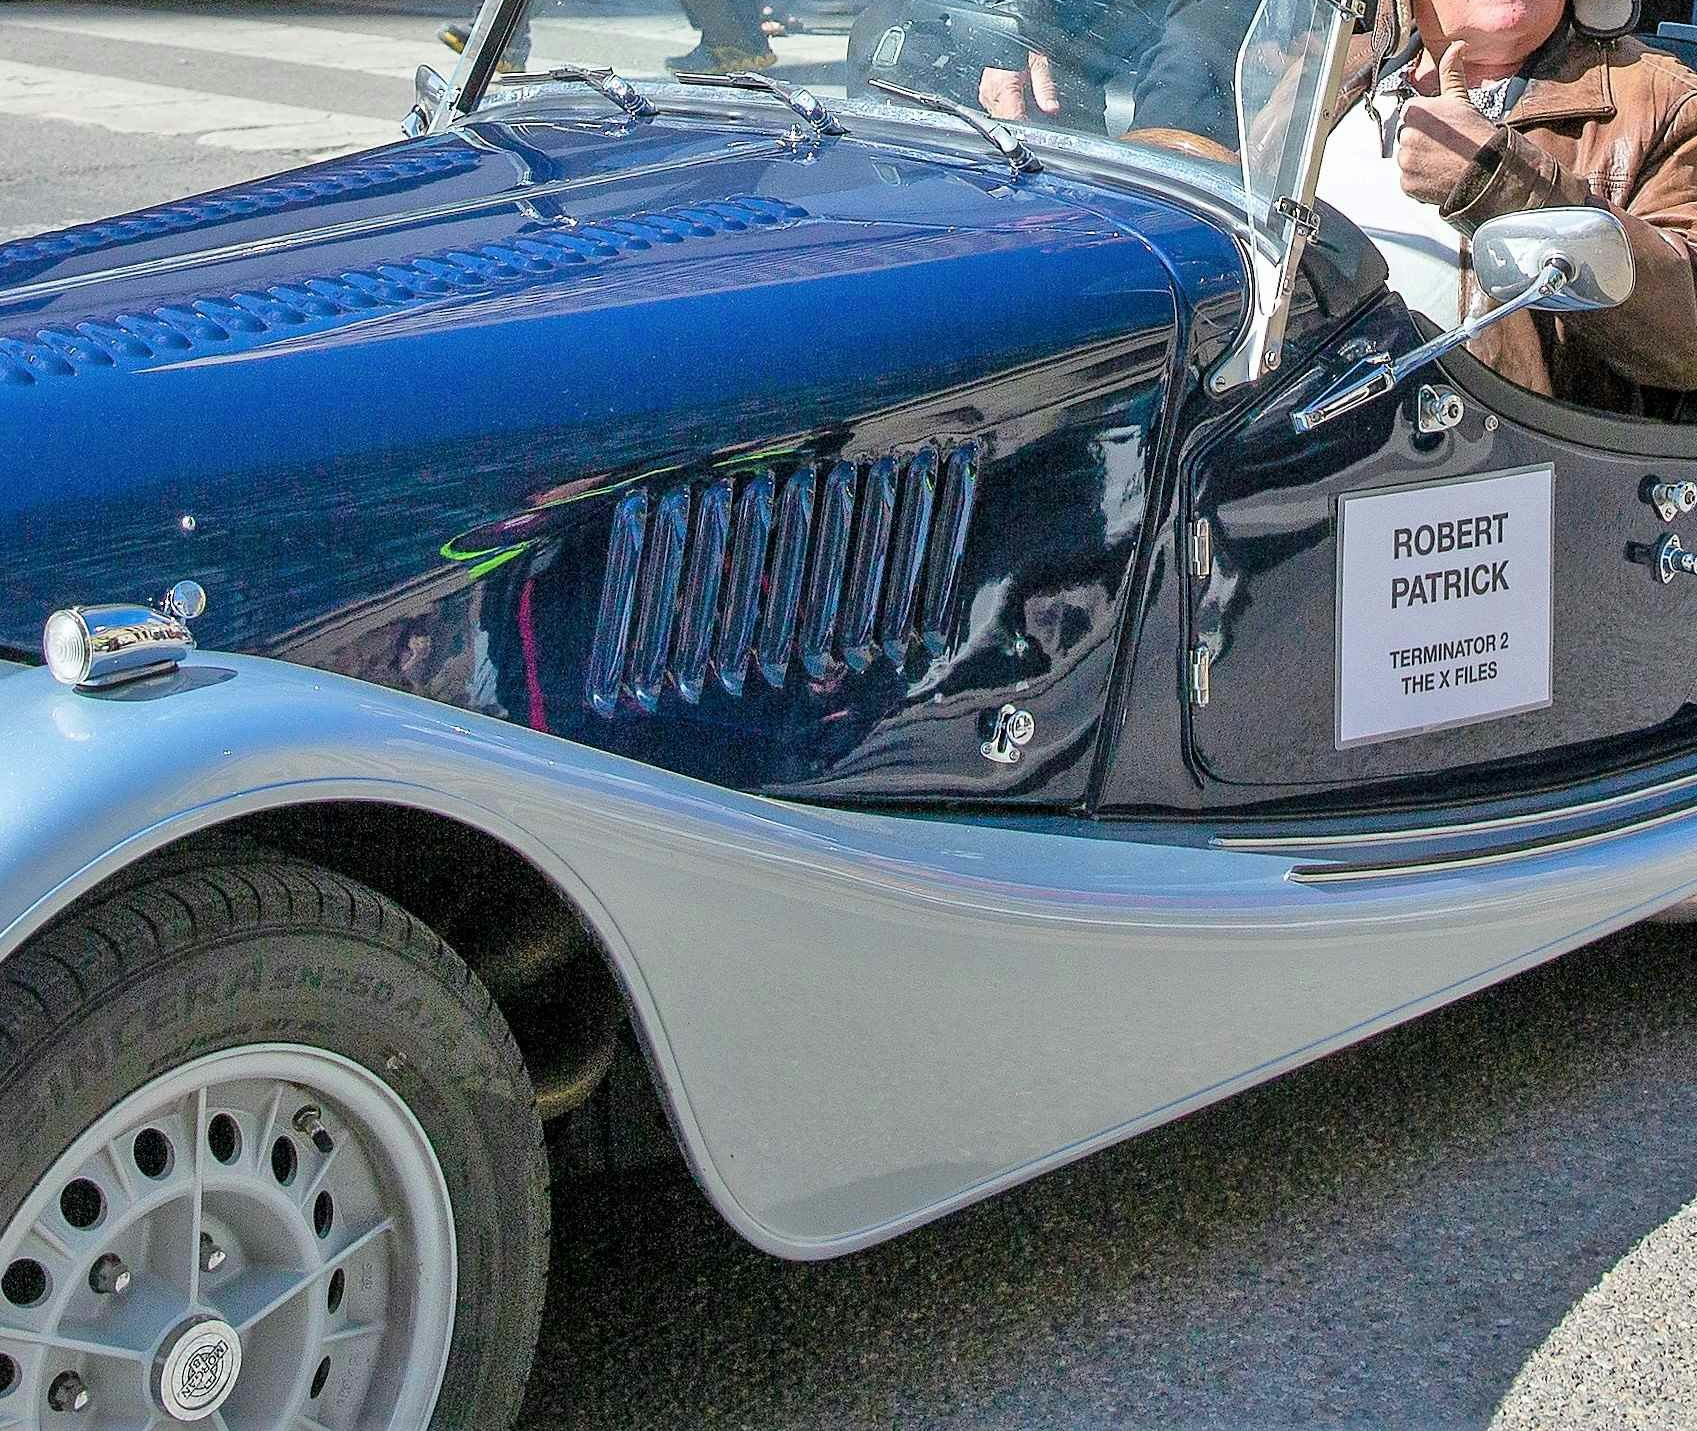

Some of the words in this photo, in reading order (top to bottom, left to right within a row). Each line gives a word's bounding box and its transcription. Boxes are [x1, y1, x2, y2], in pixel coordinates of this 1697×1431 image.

[1393, 511, 1510, 561] ROBERT
[1390, 559, 1511, 610] PATRICK
[1389, 633, 1496, 669] TERMINATOR
[1499, 631, 1510, 650] 2
[1401, 673, 1435, 695] THE
[1438, 670, 1451, 689] X
[1455, 660, 1499, 687] FILES
[181, 1344, 225, 1398] MORGAN
